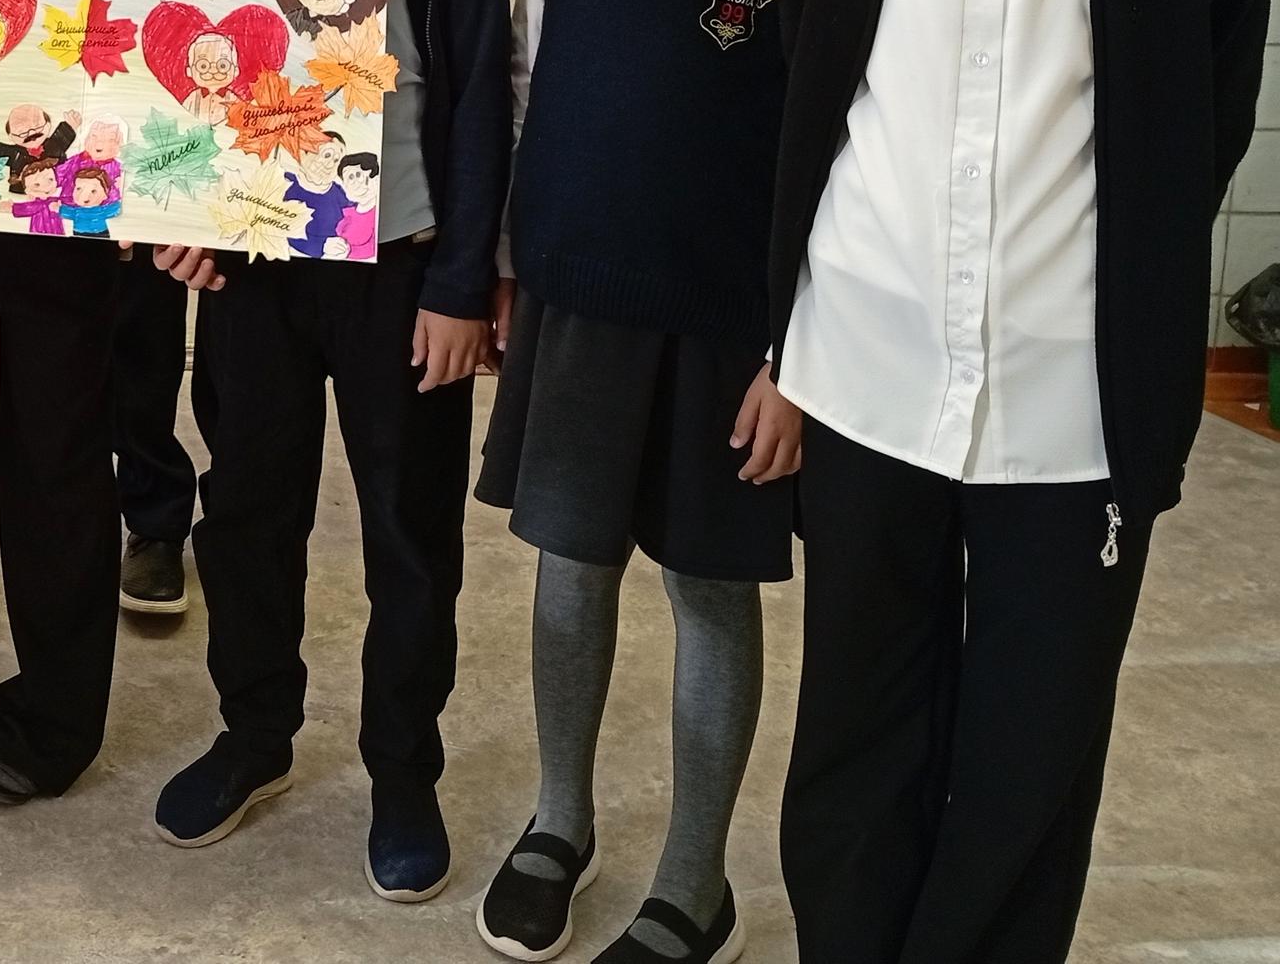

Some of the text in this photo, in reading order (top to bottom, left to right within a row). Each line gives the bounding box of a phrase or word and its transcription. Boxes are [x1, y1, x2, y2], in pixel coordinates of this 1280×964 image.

[720, 3, 744, 24] 99
[54, 21, 119, 34] внимания
[51, 36, 120, 54] от детей
[338, 61, 384, 90] ласки
[243, 97, 317, 128] душевной
[249, 112, 331, 139] молодости
[148, 140, 200, 174] тепла
[227, 188, 297, 218] домашнего
[249, 213, 291, 231] уюта
